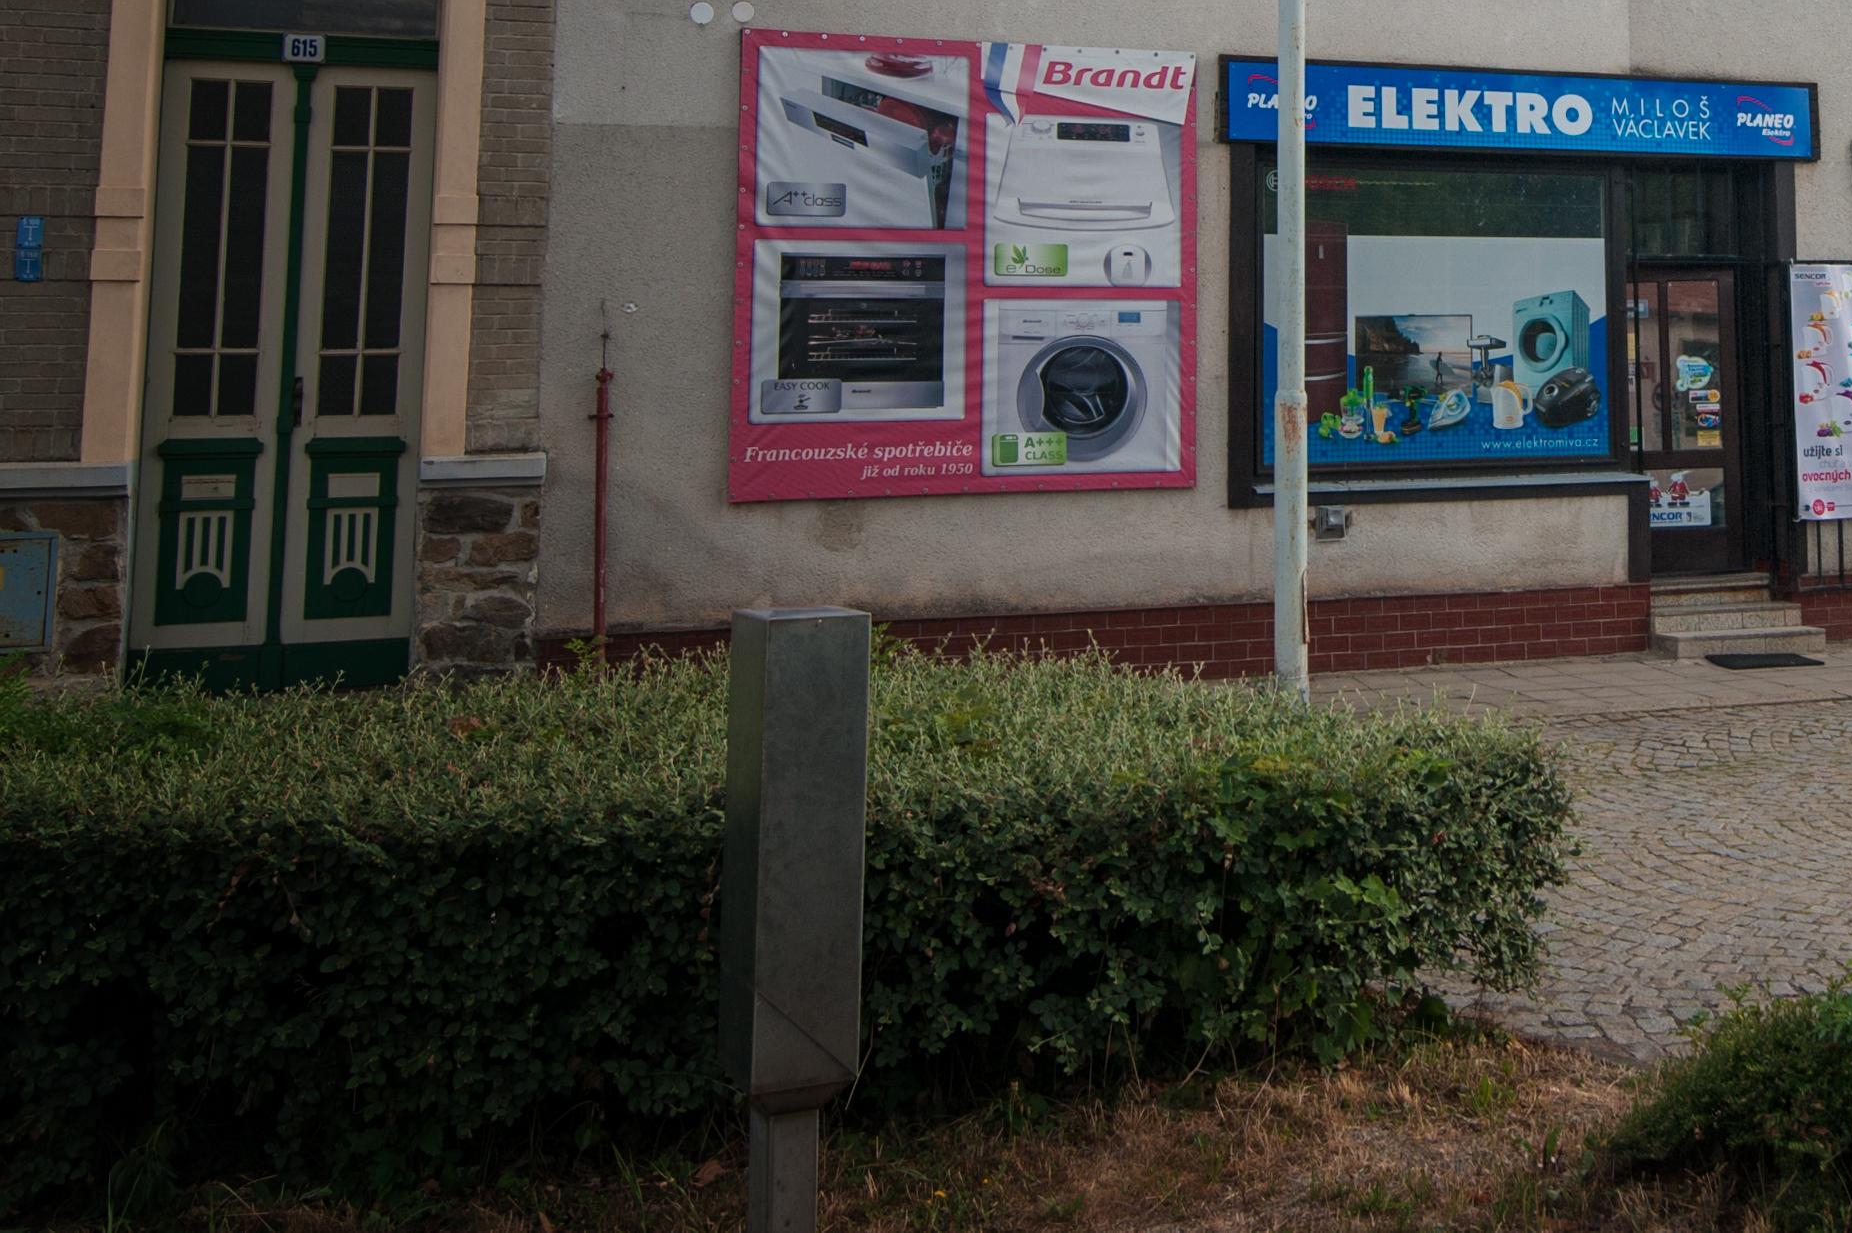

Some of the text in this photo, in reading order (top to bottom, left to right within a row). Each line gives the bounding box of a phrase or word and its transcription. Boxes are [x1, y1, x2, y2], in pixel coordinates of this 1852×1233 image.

[291, 38, 318, 57] 615
[1042, 60, 1186, 90] Brandt
[1247, 92, 1318, 111] PLAO
[1347, 84, 1593, 136] ELEKTRO
[1611, 114, 1711, 140] VÁCLAVEK
[1736, 112, 1794, 129] PLANEO
[1024, 264, 1062, 274] Dose
[774, 381, 831, 391] EASY COOK
[1024, 436, 1064, 449] A+++
[1481, 435, 1599, 449] www.elektromiva.cz
[744, 441, 973, 463] Francouzské spotřebiče
[1025, 450, 1064, 461] CLASS
[1803, 444, 1843, 459] užijte si
[860, 463, 974, 480] již od roku 1950
[1802, 469, 1851, 483] ovocných
